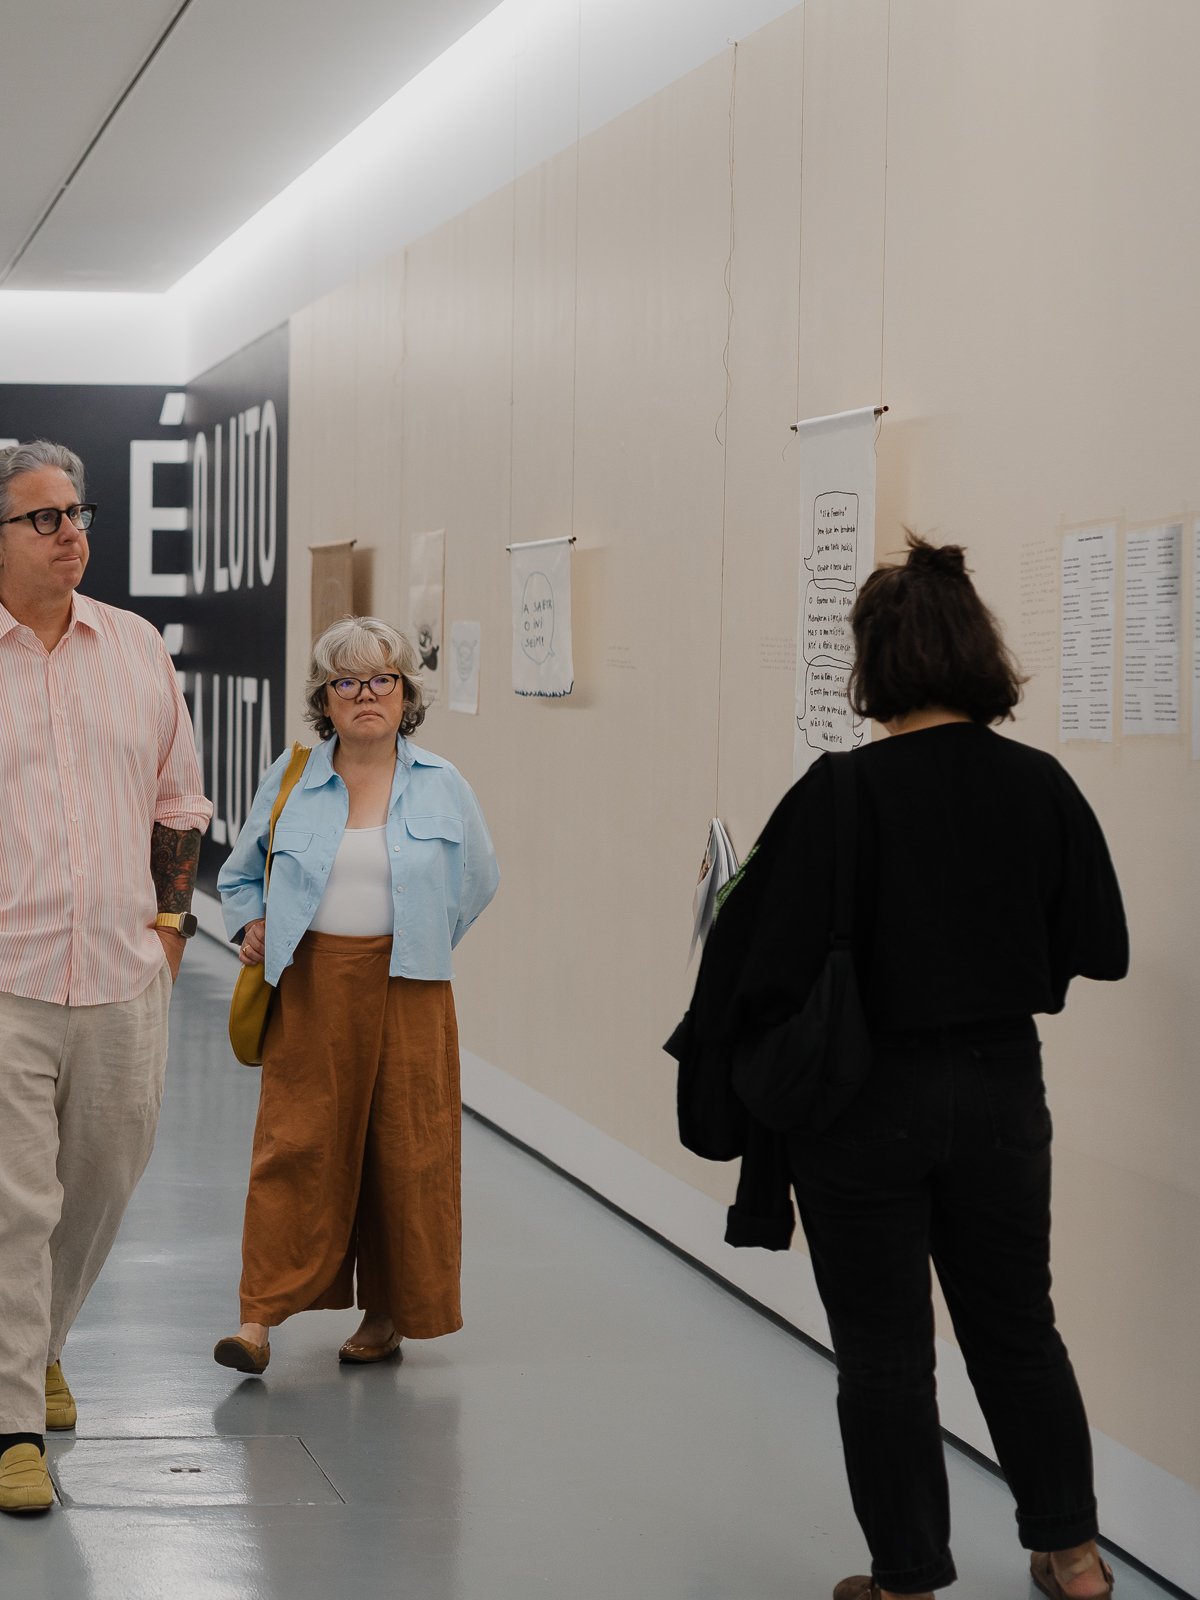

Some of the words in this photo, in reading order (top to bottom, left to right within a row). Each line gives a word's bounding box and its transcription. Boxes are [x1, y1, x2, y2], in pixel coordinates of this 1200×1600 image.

[129, 392, 188, 597] É
[192, 431, 208, 595] O
[213, 400, 278, 593] LUTO
